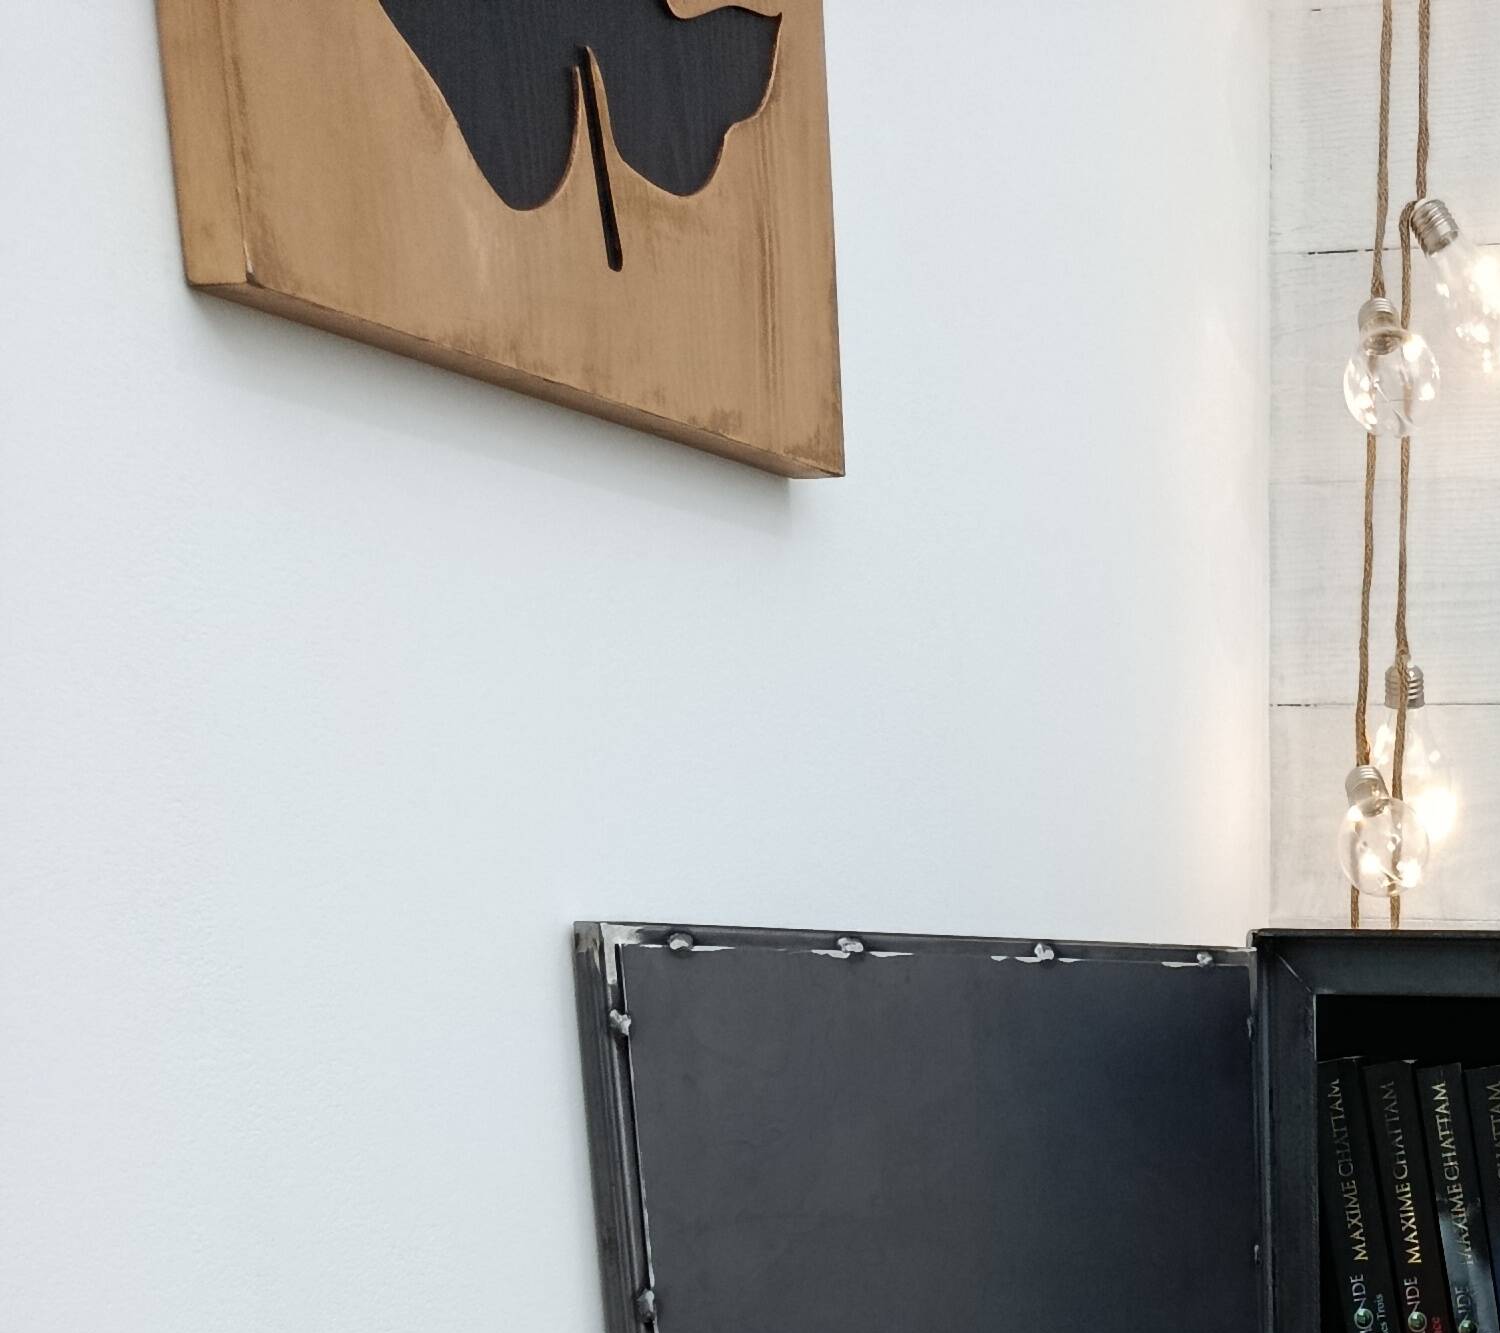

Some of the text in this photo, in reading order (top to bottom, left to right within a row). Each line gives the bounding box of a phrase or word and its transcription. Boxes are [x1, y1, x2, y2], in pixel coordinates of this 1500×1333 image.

[1327, 1078, 1369, 1261] MAXIME CHATTAM
[1379, 1081, 1423, 1264] MAXIME CHATTAM
[1431, 1081, 1475, 1265] MAXIME CHATTAM
